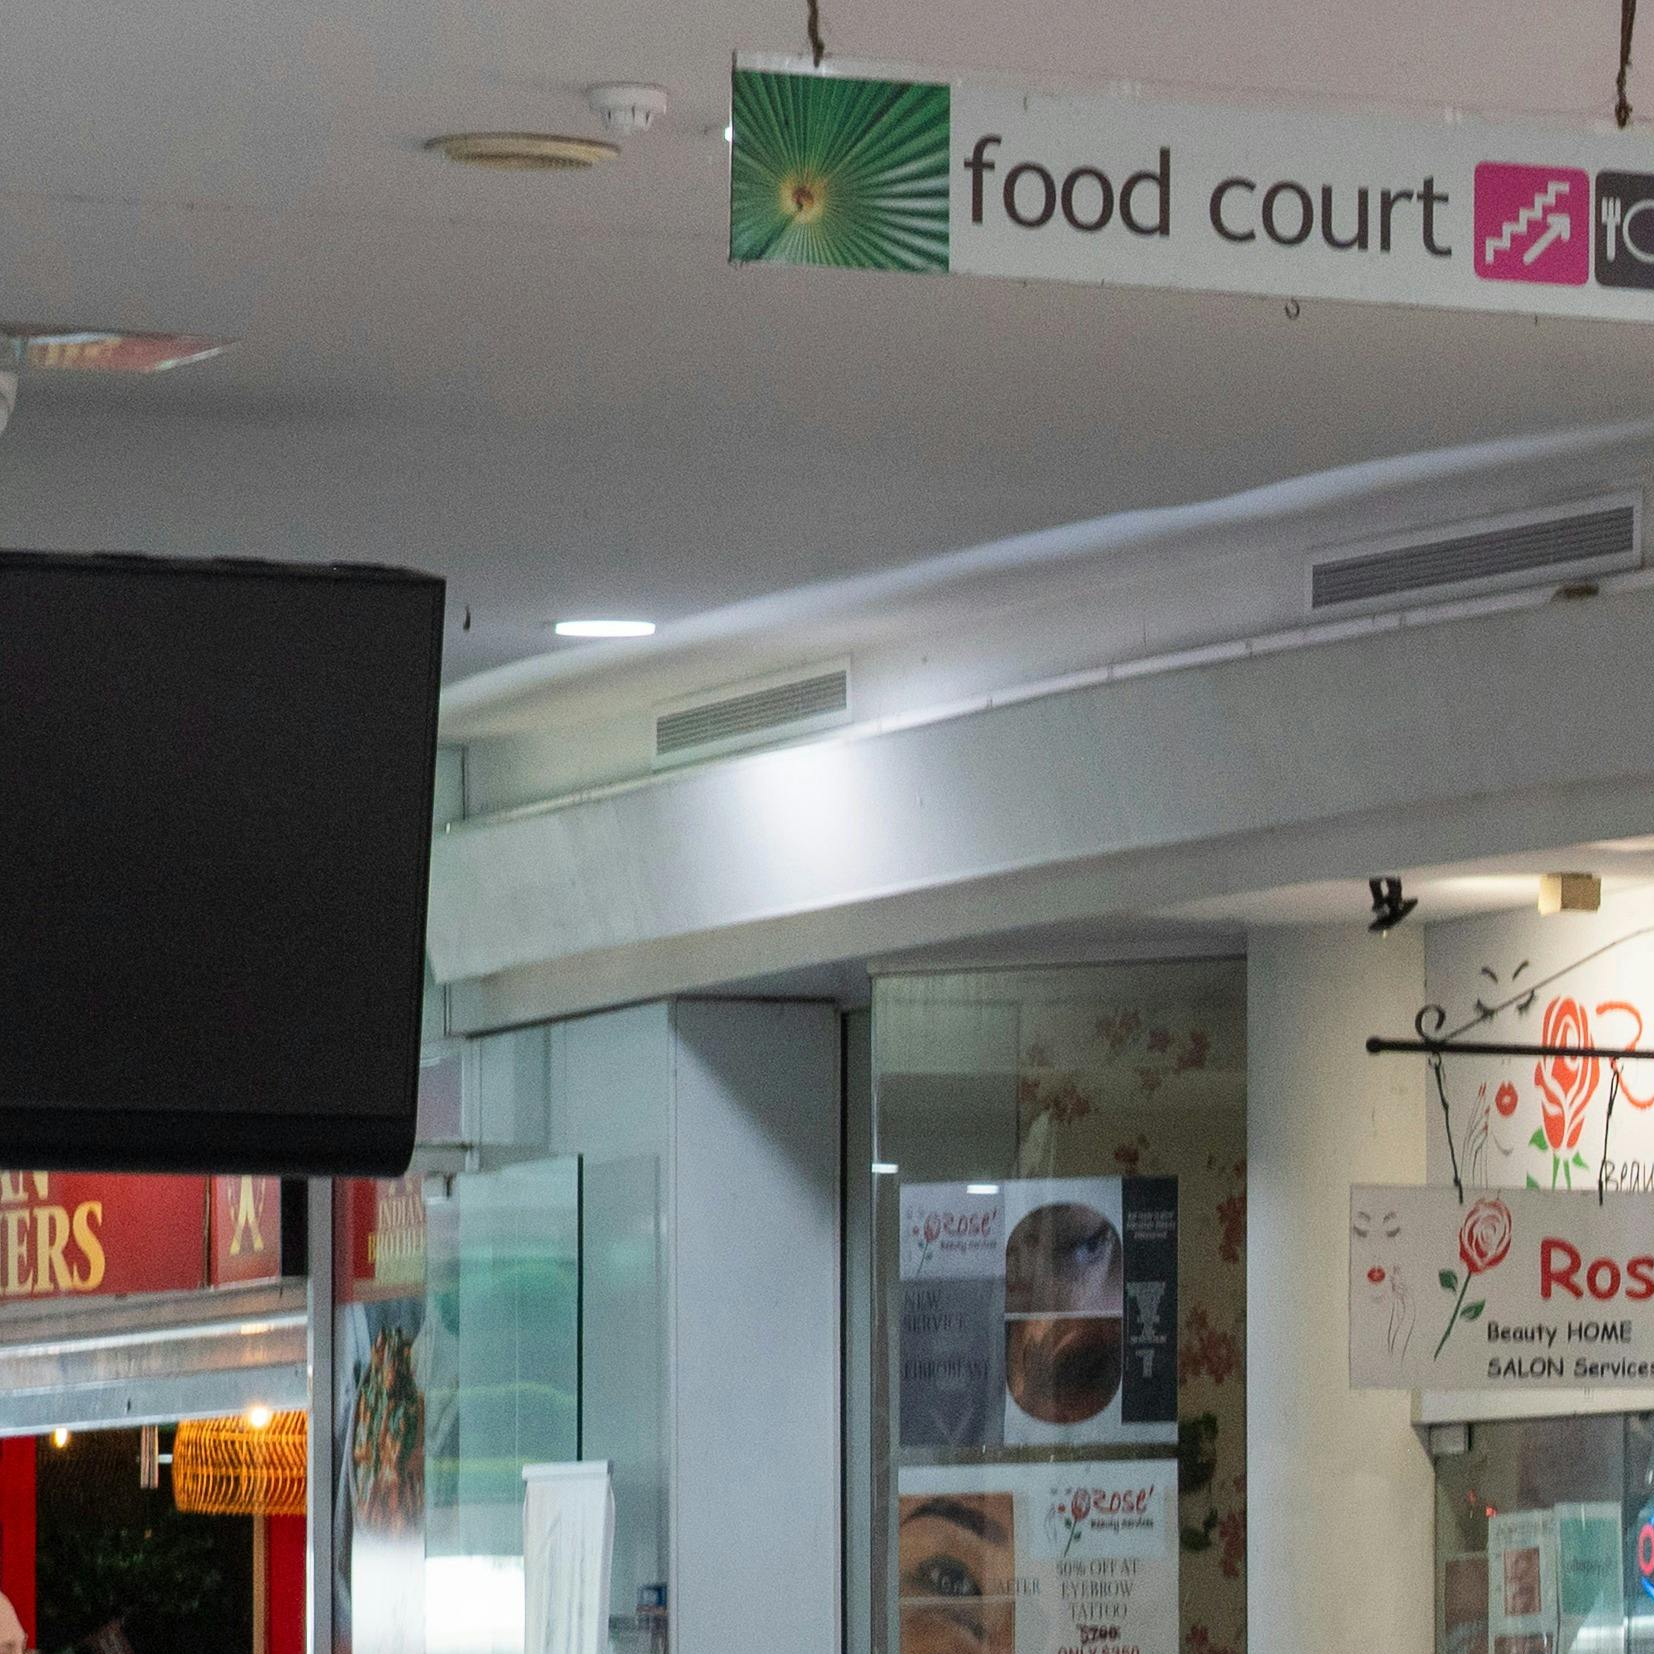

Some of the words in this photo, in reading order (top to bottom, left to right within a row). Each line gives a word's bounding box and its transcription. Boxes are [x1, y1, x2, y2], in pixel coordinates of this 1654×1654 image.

[963, 135, 1171, 237] food
[1208, 175, 1452, 257] court
[1486, 1320, 1556, 1347] Beauty
[1567, 1320, 1633, 1343] HOME
[1486, 1357, 1564, 1378] SALON
[1061, 1581, 1133, 1598] EYEBROW
[1069, 1604, 1128, 1619] TATTOO
